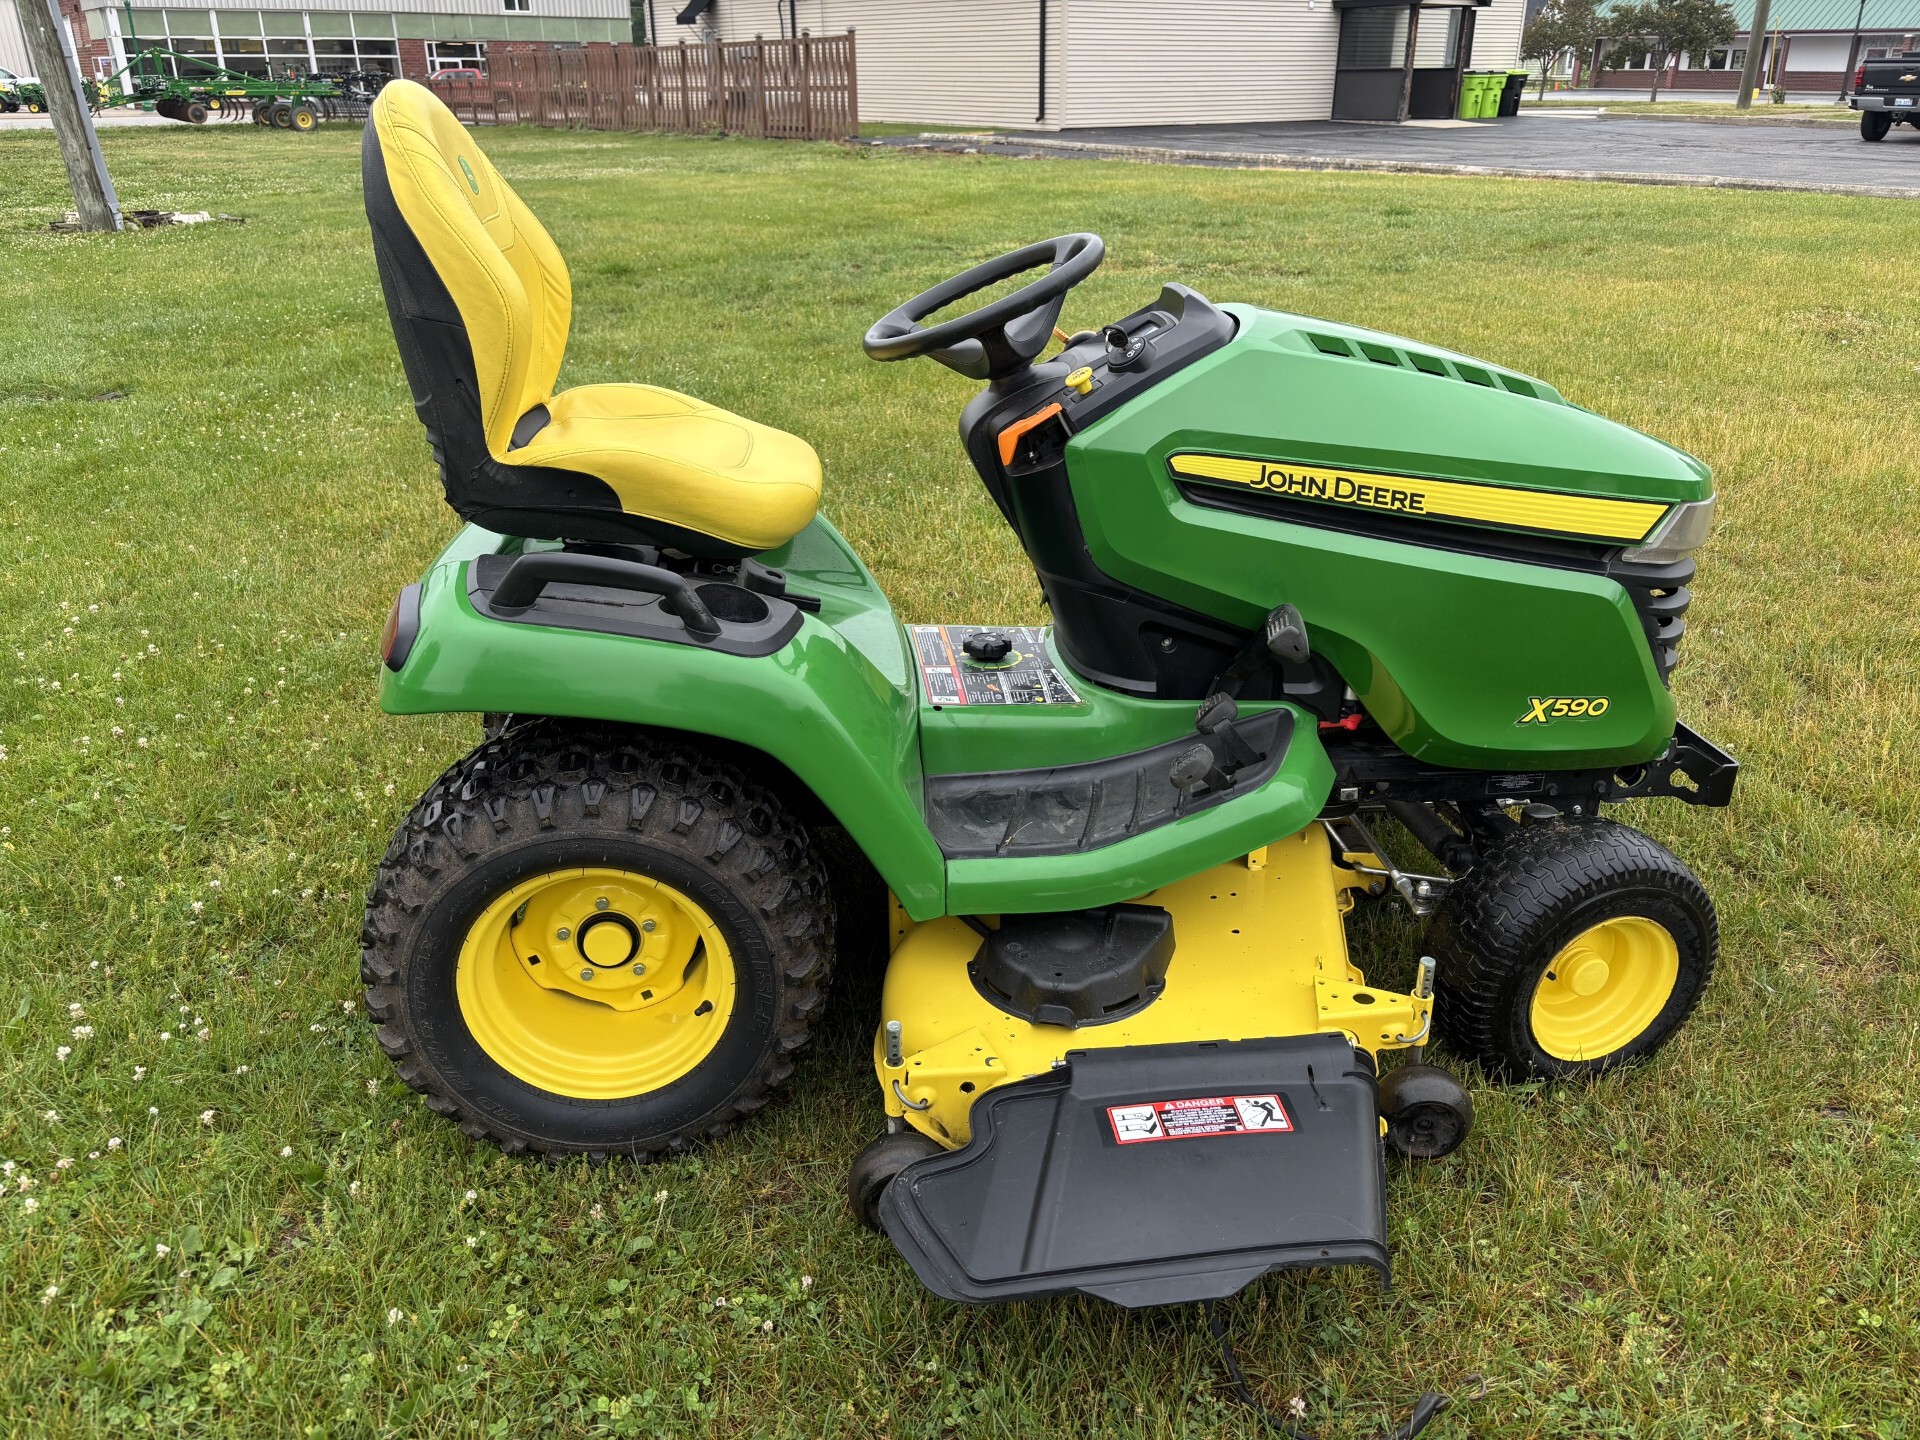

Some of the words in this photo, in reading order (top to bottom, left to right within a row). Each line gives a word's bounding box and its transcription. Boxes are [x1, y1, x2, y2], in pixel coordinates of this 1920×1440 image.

[1249, 464, 1328, 498] JOHN
[1334, 476, 1426, 513] DEERE
[1517, 696, 1610, 724] X590
[698, 881, 773, 1035] CARLISLE
[1176, 1098, 1225, 1108] DANGER
